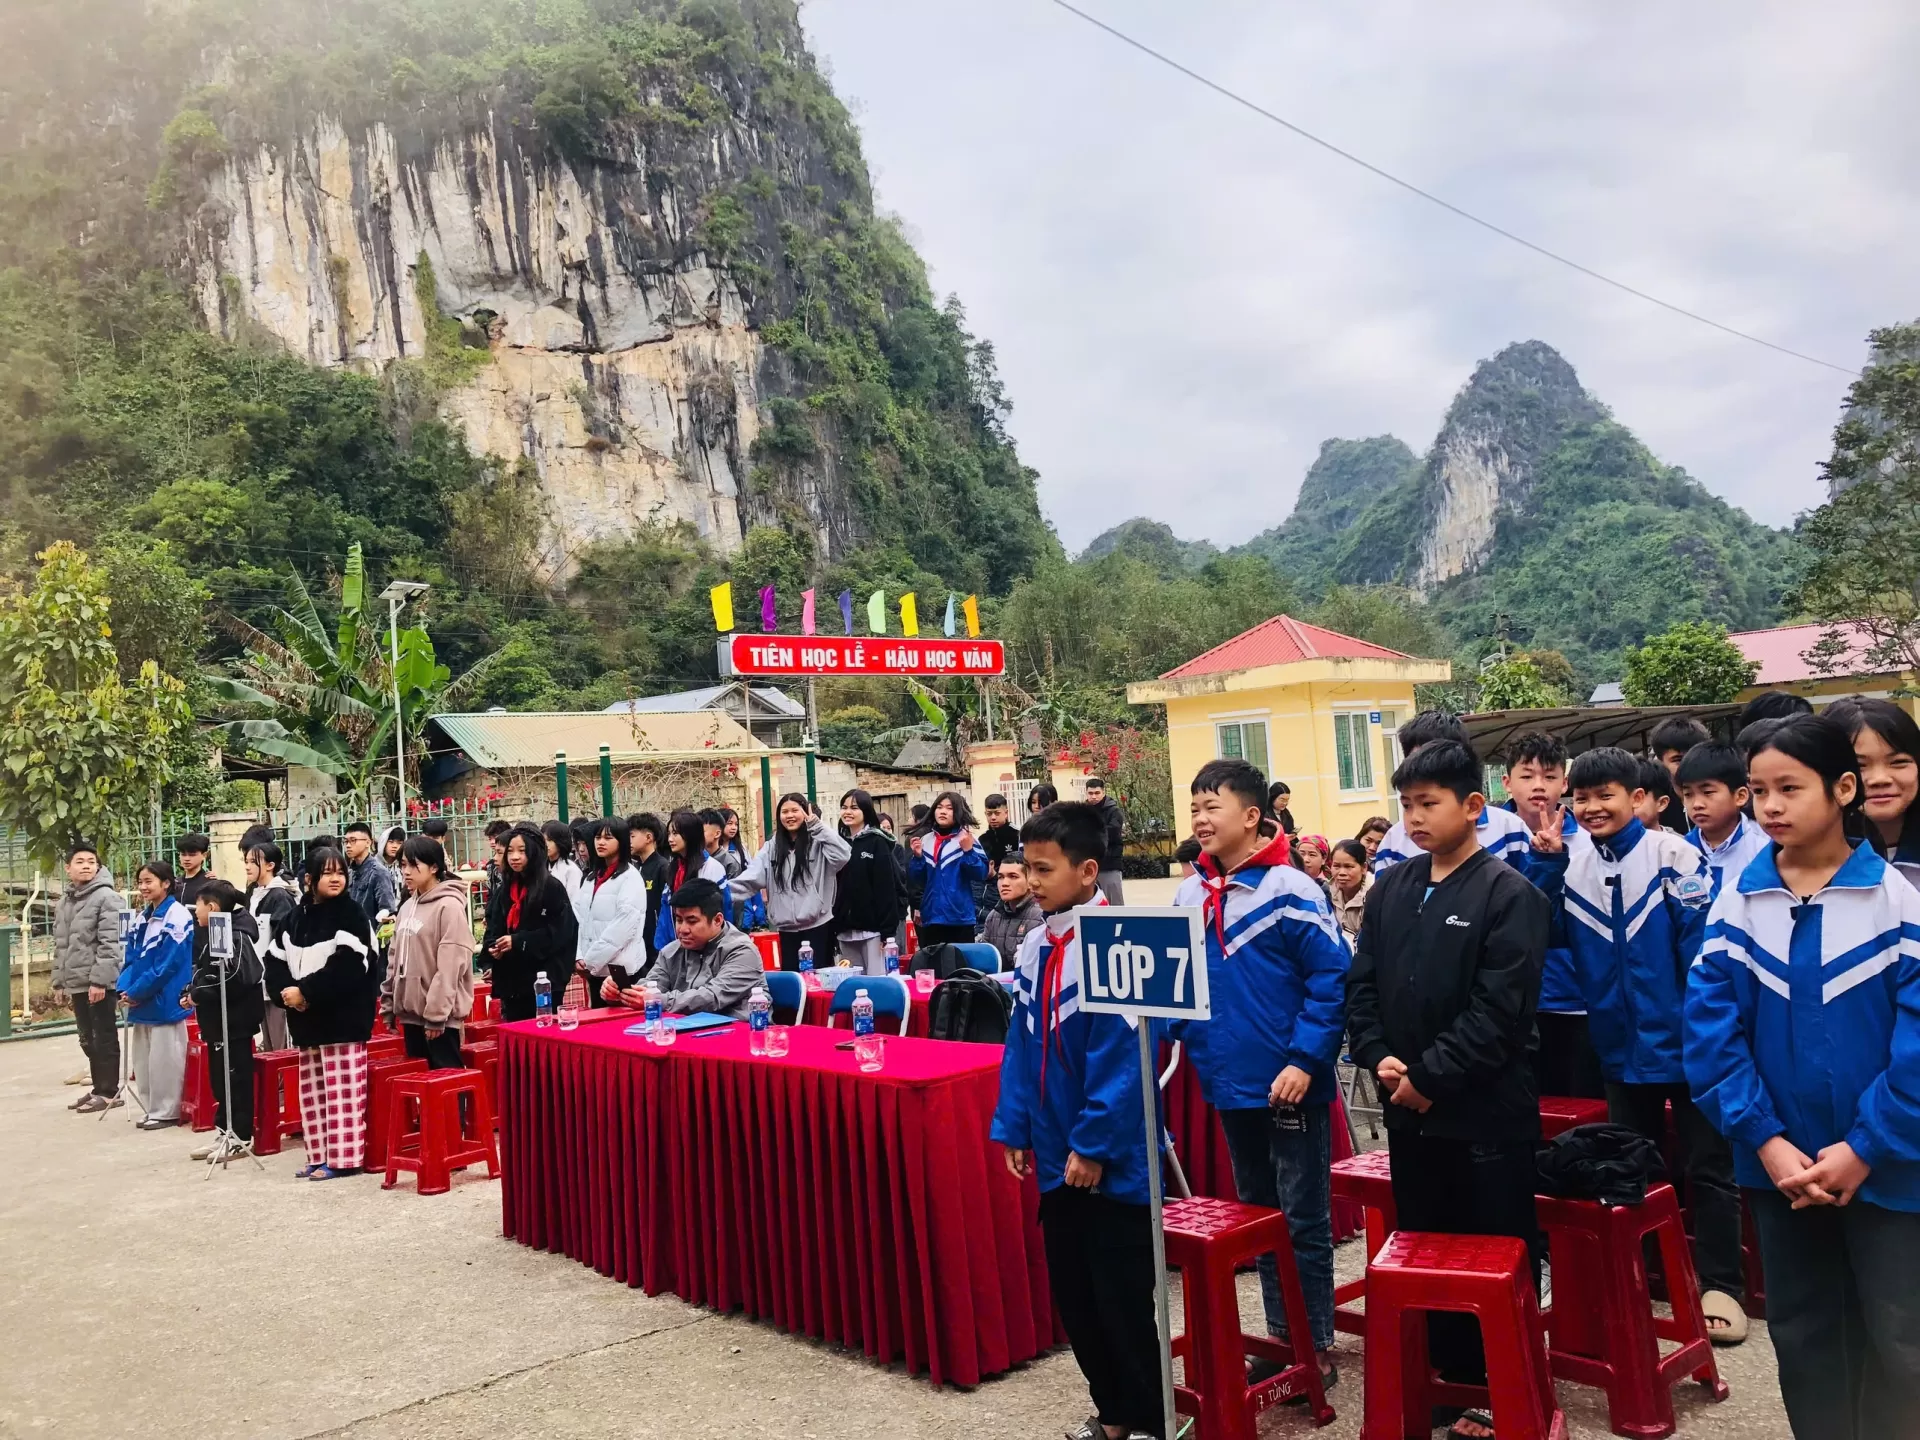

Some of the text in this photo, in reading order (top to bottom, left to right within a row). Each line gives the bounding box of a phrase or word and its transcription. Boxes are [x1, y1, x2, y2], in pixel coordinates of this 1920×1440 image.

[750, 642, 794, 668] TIÊN
[801, 648, 838, 672] HỌC
[844, 641, 866, 668] LỄ
[885, 645, 919, 672] HẬU
[925, 650, 957, 672] HỌC
[962, 647, 993, 668] VĂN
[1087, 923, 1189, 1003] LỚP 7
[1268, 1382, 1291, 1401] TÙNG
